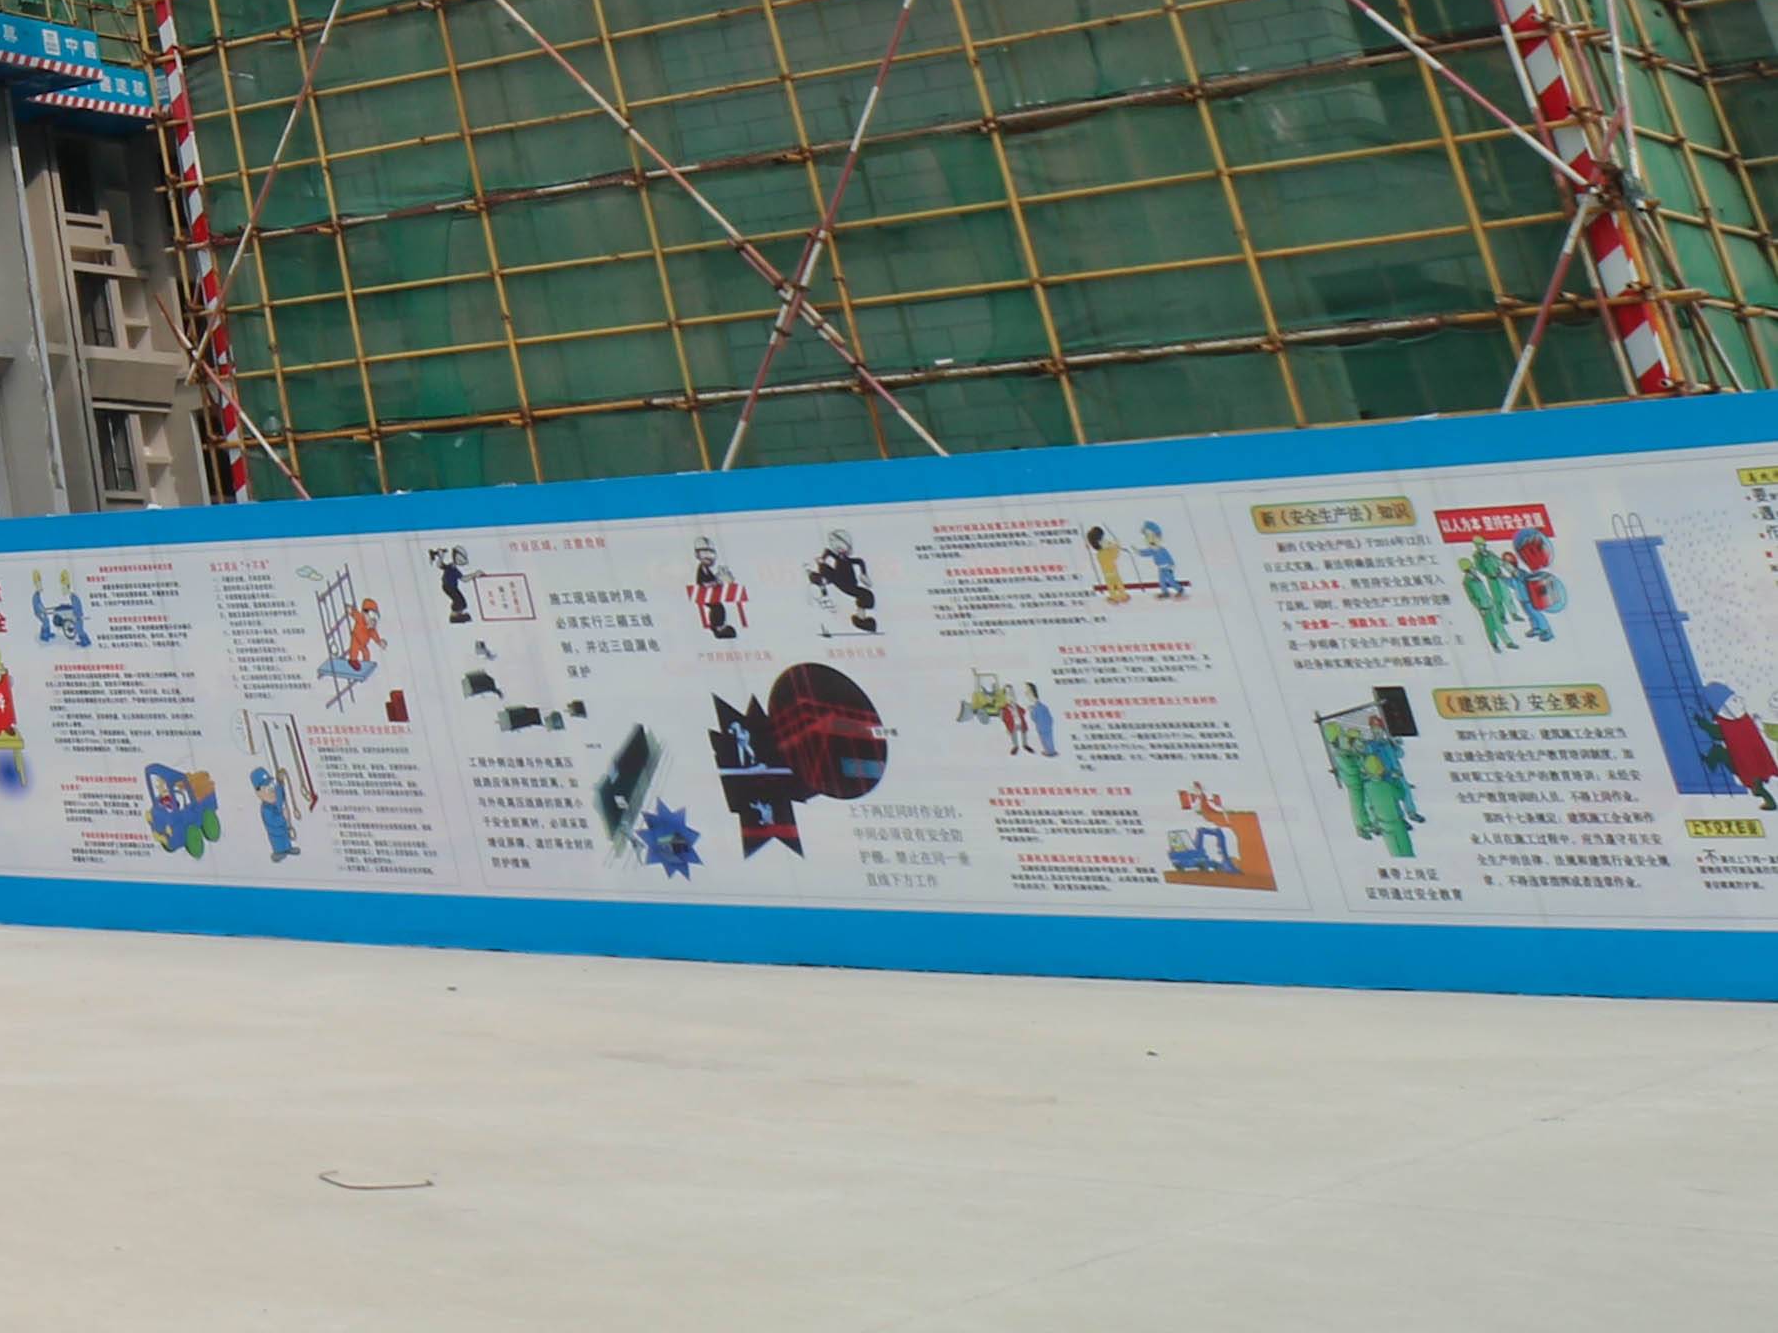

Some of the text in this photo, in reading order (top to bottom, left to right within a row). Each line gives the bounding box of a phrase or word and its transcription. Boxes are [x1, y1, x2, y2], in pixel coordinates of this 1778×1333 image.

[549, 589, 648, 606] 施工现场临时用电
[555, 613, 654, 630] 必须实行三箱五线
[566, 665, 592, 679] 保护
